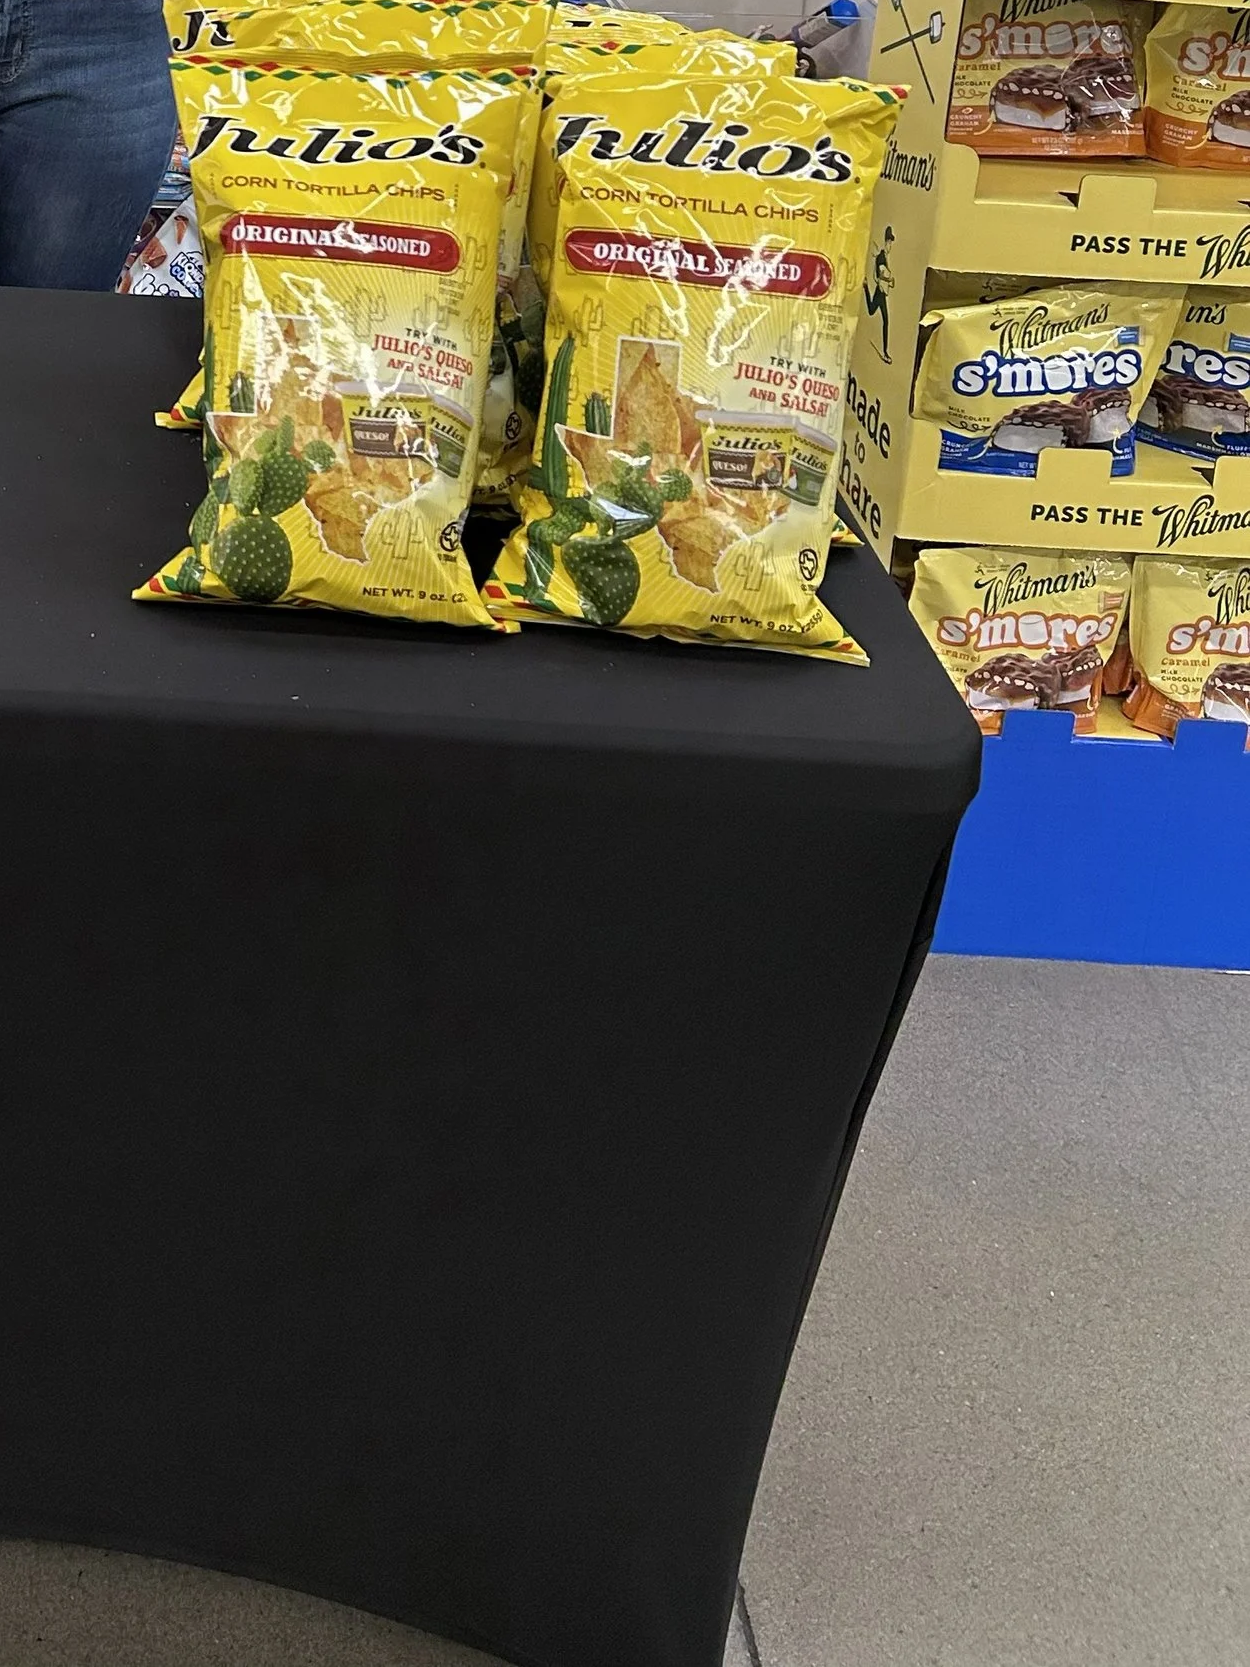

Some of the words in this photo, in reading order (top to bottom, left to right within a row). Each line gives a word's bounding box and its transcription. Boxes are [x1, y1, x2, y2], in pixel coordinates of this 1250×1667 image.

[1171, 92, 1214, 105] CHOCOLATE
[188, 114, 485, 168] Julio's
[556, 115, 852, 184] Julio's
[880, 138, 937, 192] itman's
[222, 175, 279, 190] CORN
[282, 179, 380, 196] TORTILLA
[387, 184, 445, 201] CHIPS
[579, 186, 641, 204] CORN
[648, 192, 748, 216] TORTILLA
[753, 204, 819, 223] CHIPS
[1070, 235, 1131, 254] PASS
[1139, 238, 1188, 257] THE
[405, 327, 428, 338] TRY
[432, 335, 458, 351] WITH
[989, 302, 1112, 360] Whitman's
[436, 349, 473, 376] QUESO
[769, 356, 794, 370] TRY
[798, 362, 827, 377] WITH
[955, 350, 1141, 394] s'mores
[733, 361, 798, 390] JULIO'S
[801, 377, 841, 402] QUESO
[749, 387, 777, 403] AND
[780, 392, 830, 418] SALSA!
[712, 435, 783, 451] Julio's
[854, 430, 866, 464] to
[839, 439, 882, 540] hare
[1031, 504, 1089, 525] PASS
[1097, 507, 1144, 527] THE
[362, 586, 387, 597] NET
[391, 588, 415, 599] WT.
[418, 589, 426, 599] 9
[973, 561, 1097, 617] Whitman's
[710, 613, 737, 625] NET
[740, 615, 764, 628] WT.
[767, 621, 775, 631] 9
[940, 611, 1118, 649] s'mores
[1160, 657, 1211, 667] Caramel
[1160, 675, 1203, 683] CHOCOLATE
